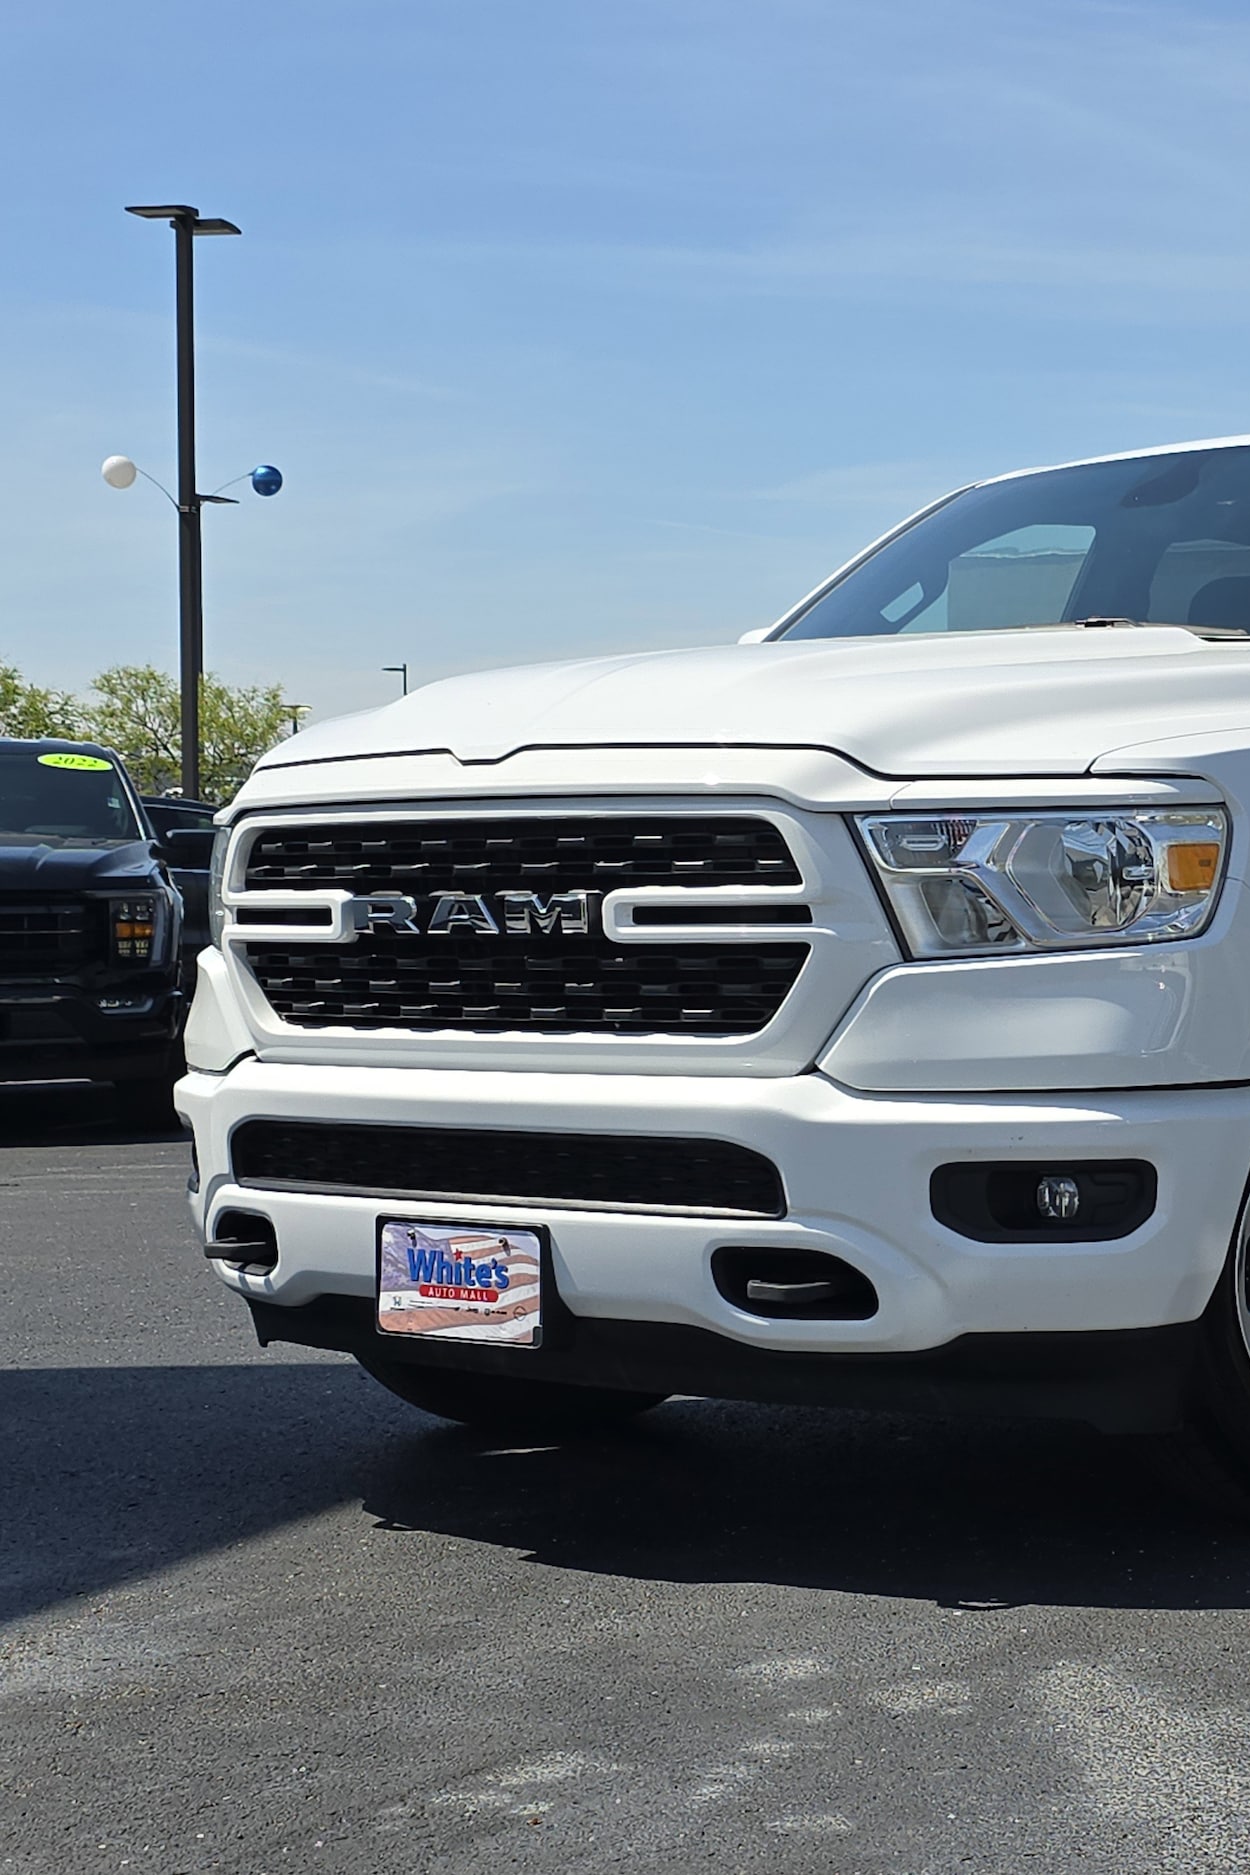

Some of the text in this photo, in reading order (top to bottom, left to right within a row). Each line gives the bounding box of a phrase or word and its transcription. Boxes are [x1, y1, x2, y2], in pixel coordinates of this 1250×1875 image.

[52, 756, 98, 767] 2022
[352, 892, 589, 935] RAM
[406, 1247, 510, 1290] White's
[427, 1286, 489, 1302] AUTO MALL
